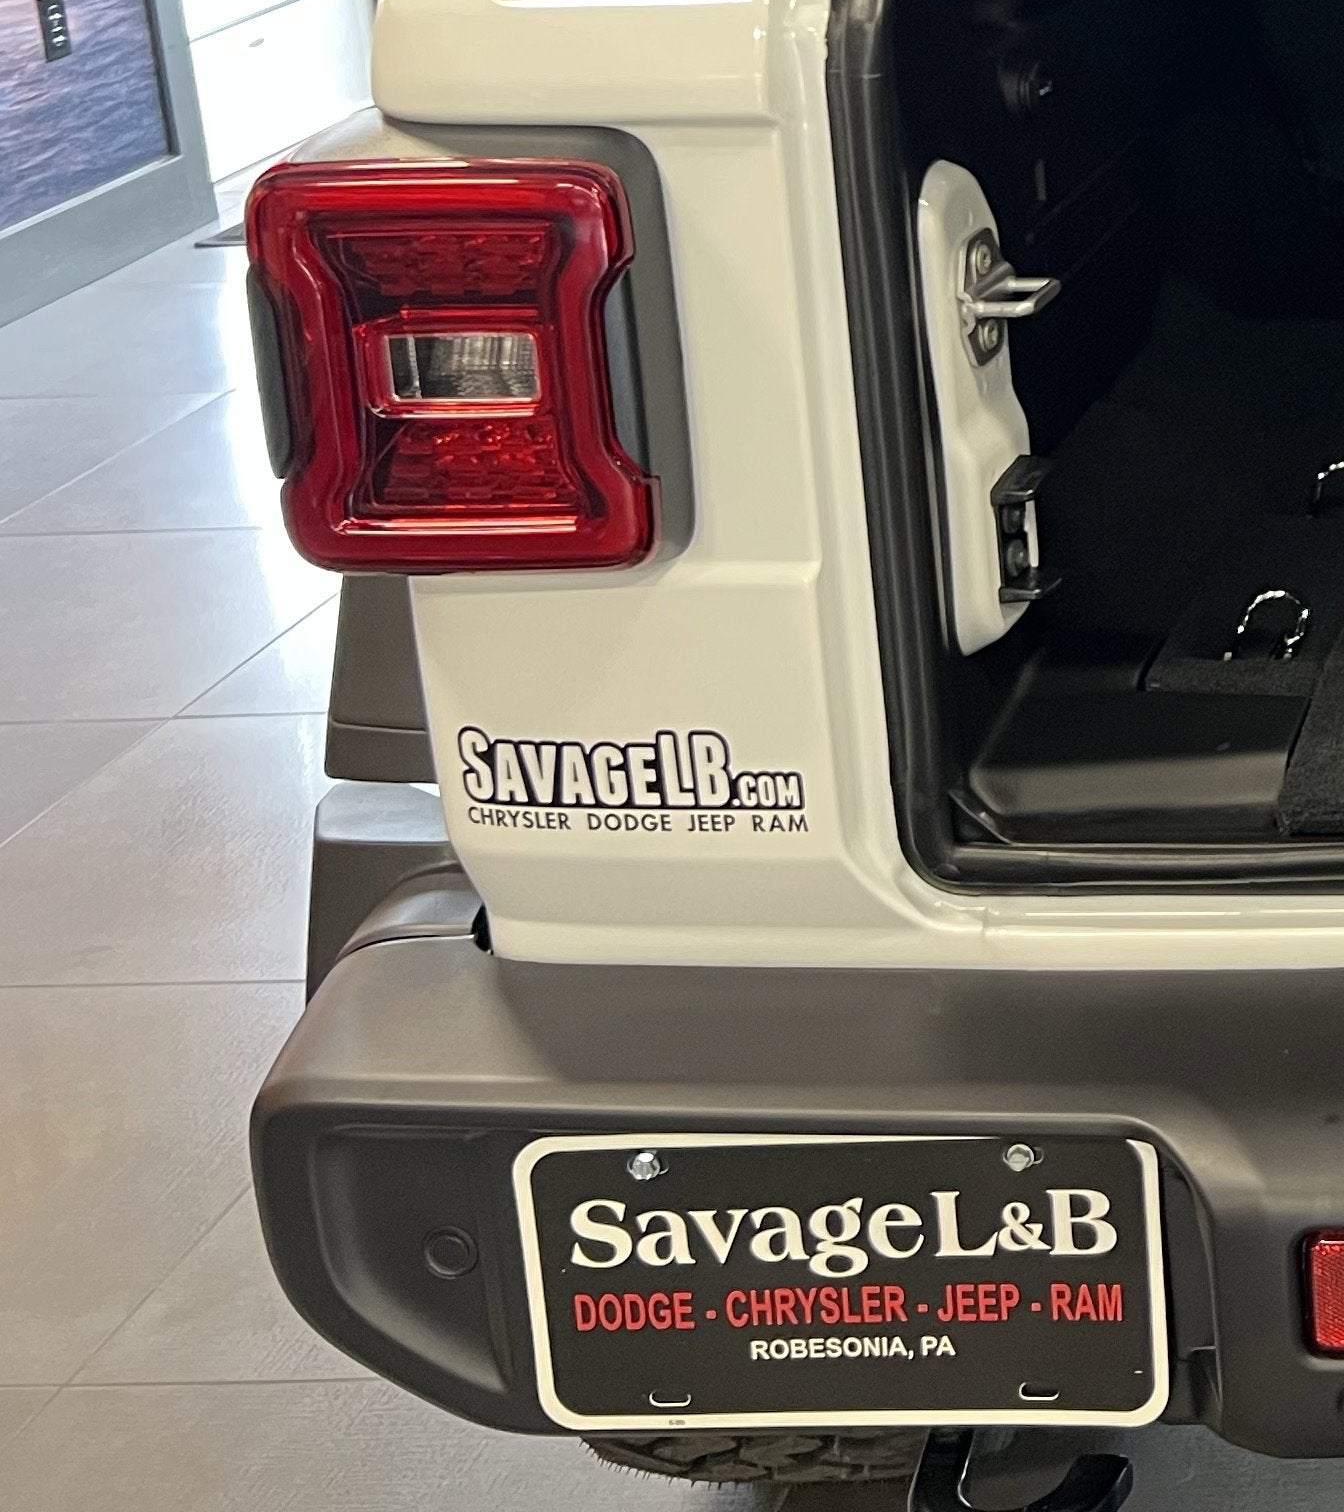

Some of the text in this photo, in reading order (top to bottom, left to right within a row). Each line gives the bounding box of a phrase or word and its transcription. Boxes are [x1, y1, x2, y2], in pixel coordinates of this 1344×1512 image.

[468, 806, 809, 832] CHRYSLER DODGE JEEP RAM
[572, 1290, 696, 1332] DODGE
[724, 1283, 908, 1328] CHRYSLER
[936, 1281, 1021, 1323] JEEP
[1049, 1281, 1124, 1321] RAM
[749, 1335, 957, 1361] ROBESONIA, PA
